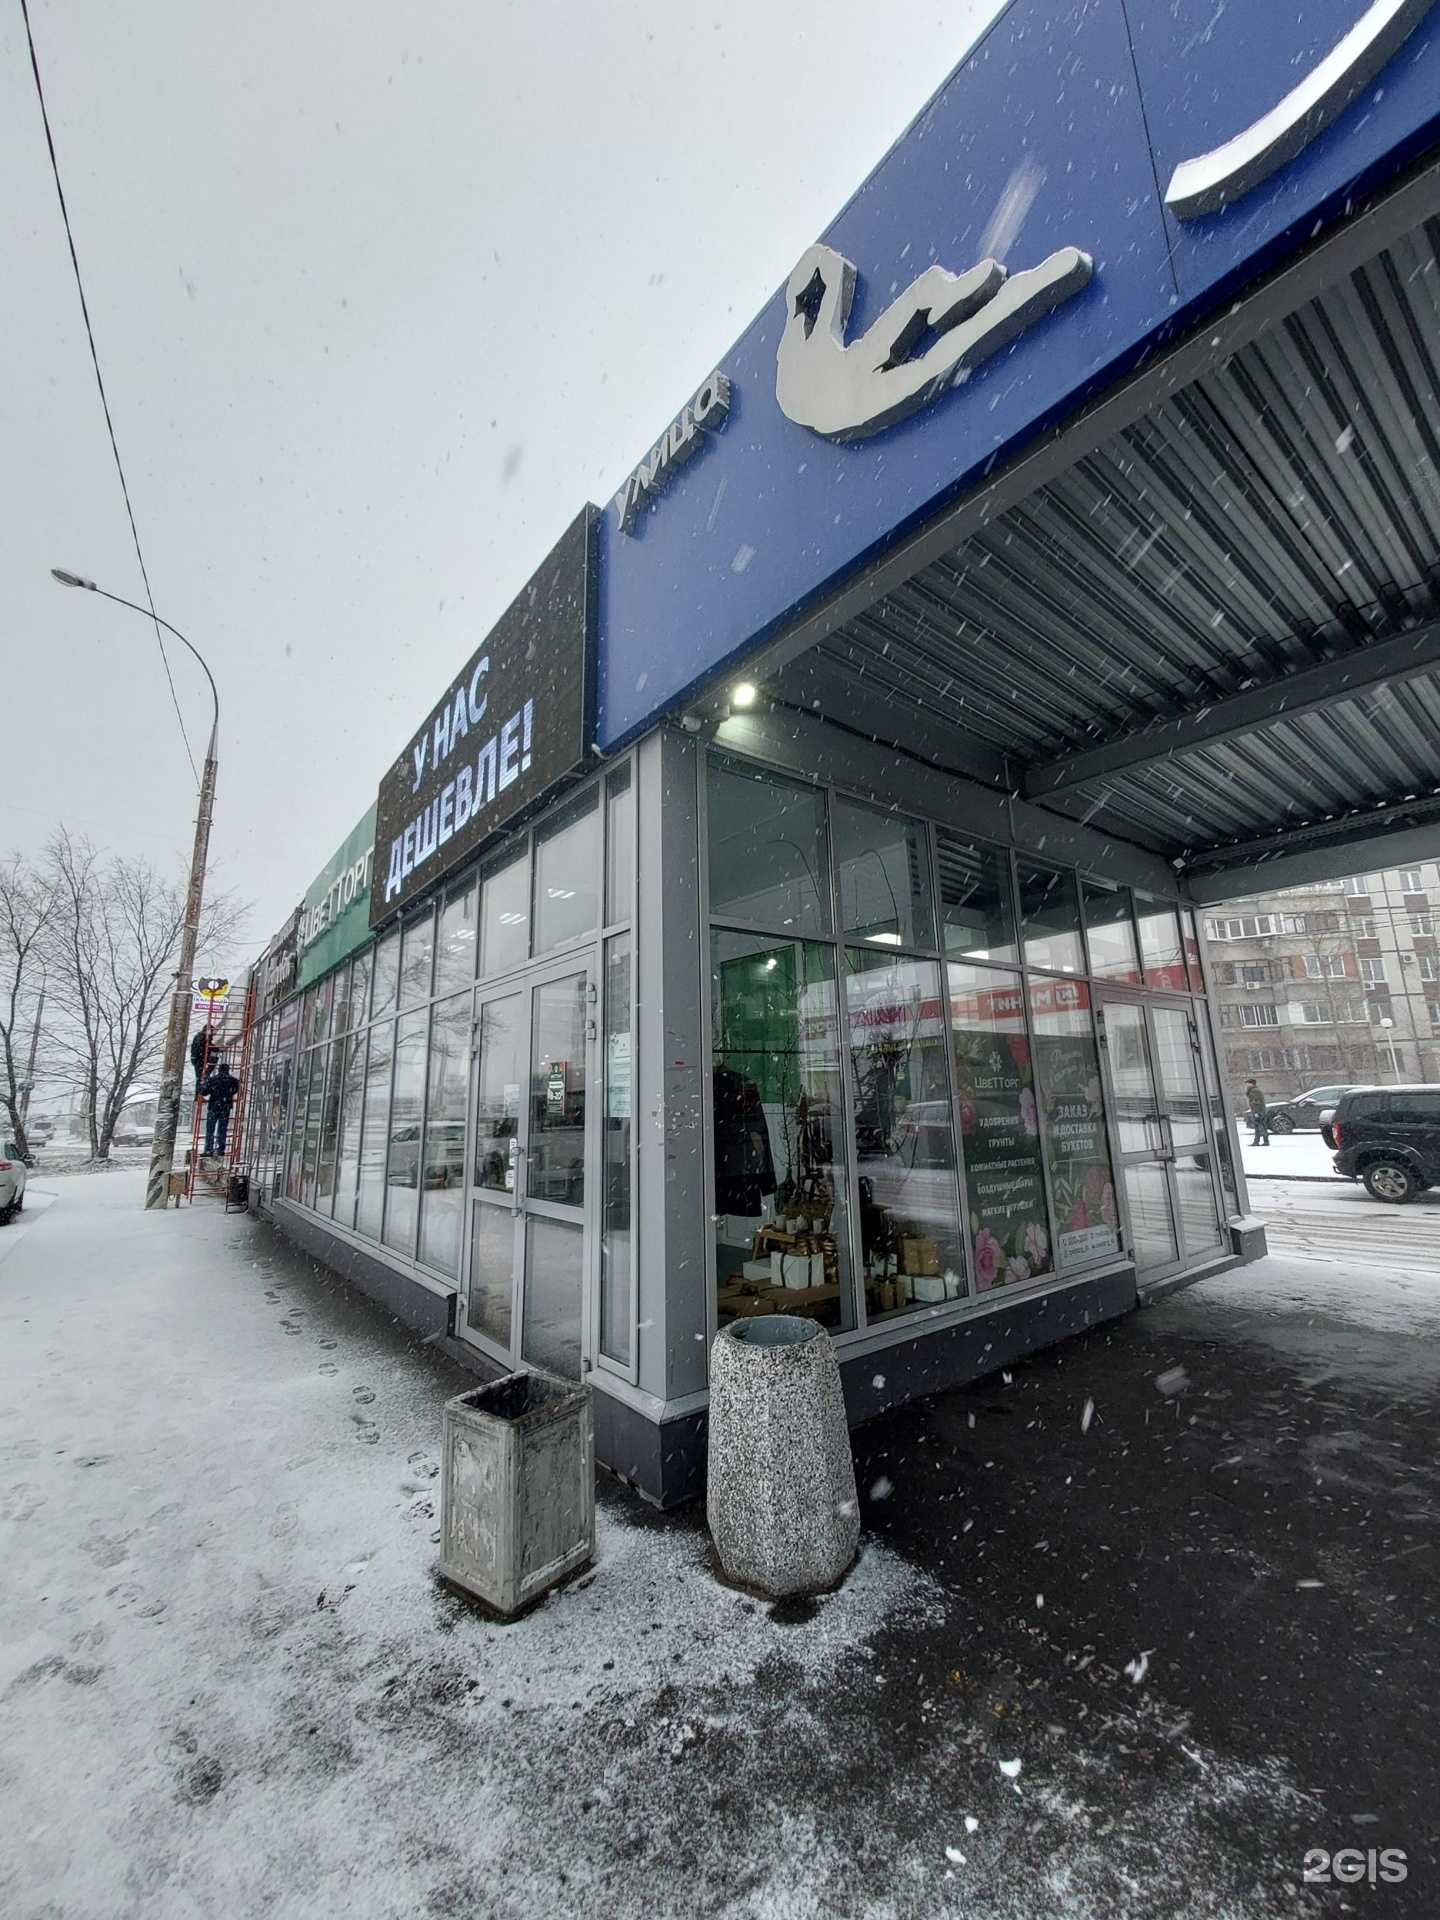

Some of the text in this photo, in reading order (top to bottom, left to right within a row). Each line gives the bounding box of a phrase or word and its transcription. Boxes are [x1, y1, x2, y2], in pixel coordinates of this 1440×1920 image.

[411, 655, 490, 793] У НАС
[384, 697, 535, 903] ДЕШЕВЛЕ!
[1055, 1104, 1088, 1119] ЗАКАЗ
[988, 1136, 1015, 1148] ГРУНТЫ
[1061, 1139, 1094, 1153] БУКЕТОВ
